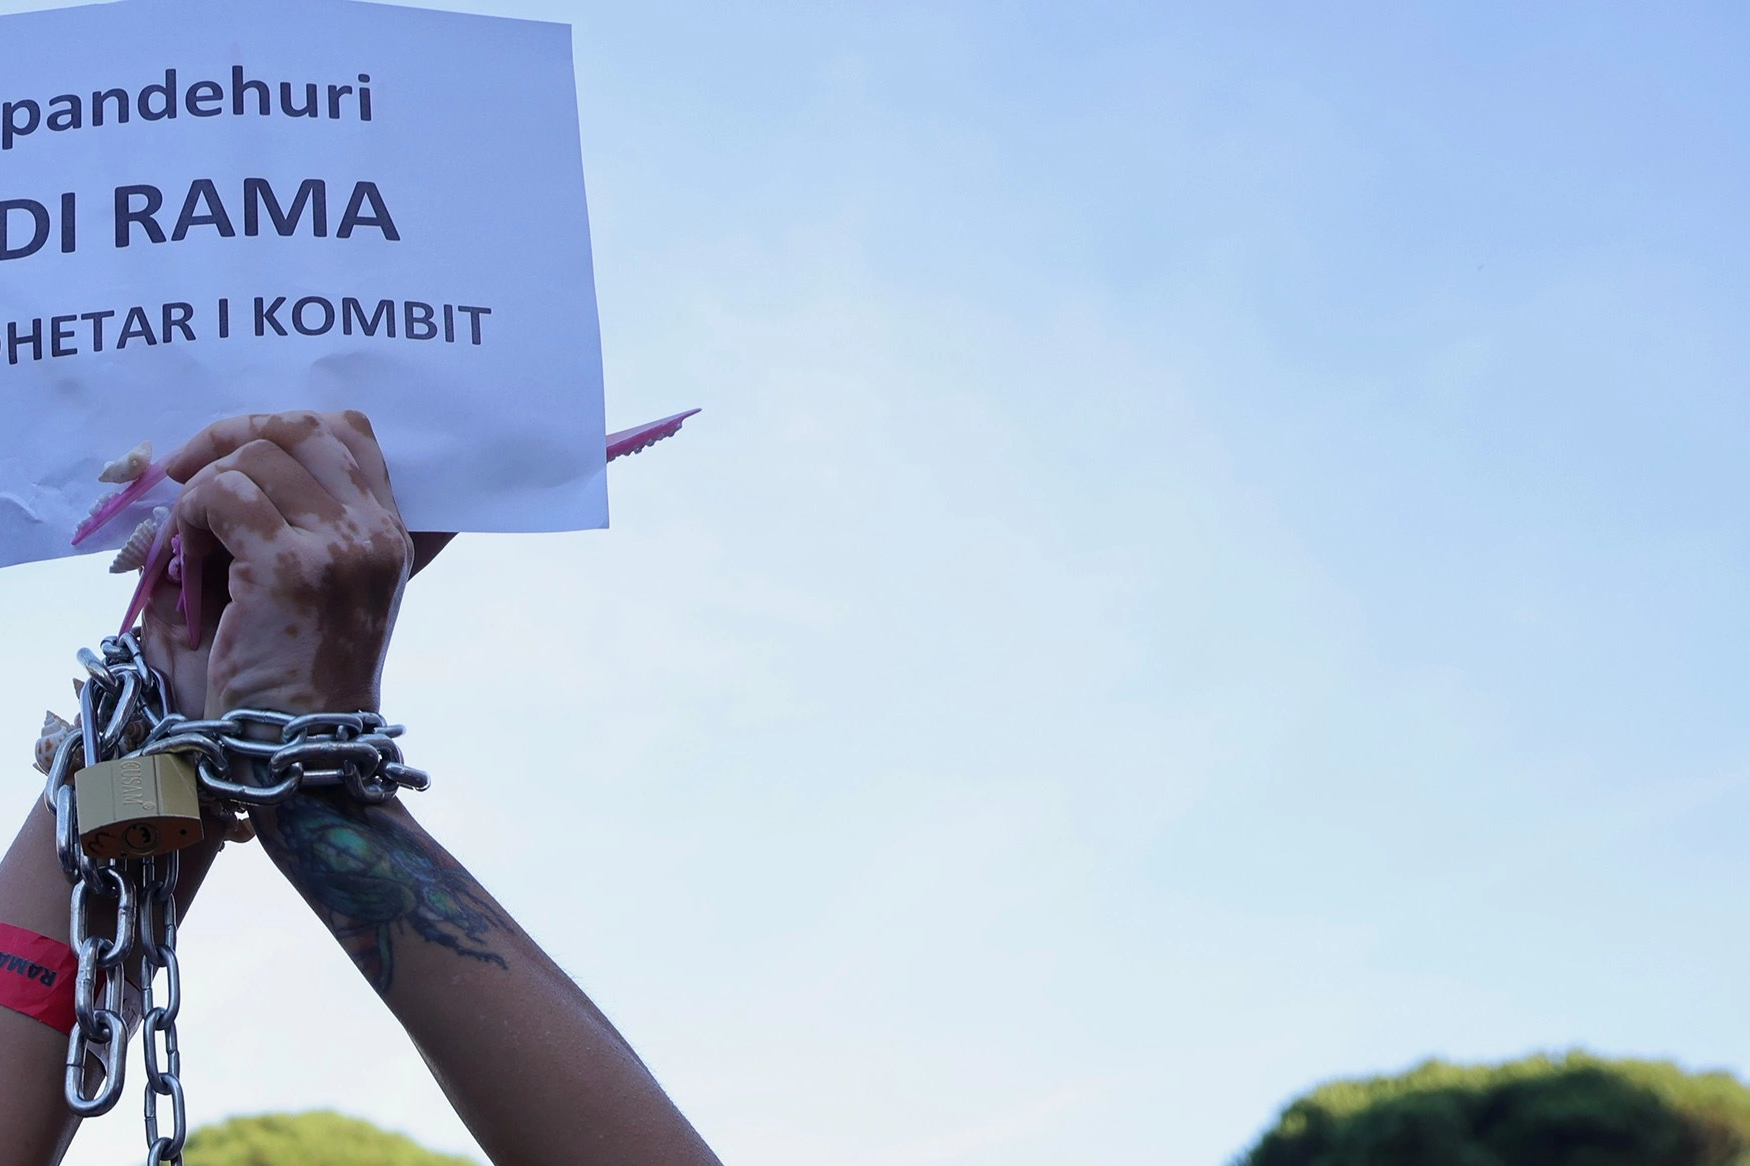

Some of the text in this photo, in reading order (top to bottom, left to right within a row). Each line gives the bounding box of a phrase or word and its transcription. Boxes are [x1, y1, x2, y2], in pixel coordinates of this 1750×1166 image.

[0, 63, 373, 151] pandehuri
[113, 177, 402, 249] RAMA
[217, 297, 230, 340] I
[252, 295, 493, 346] KOMBIT
